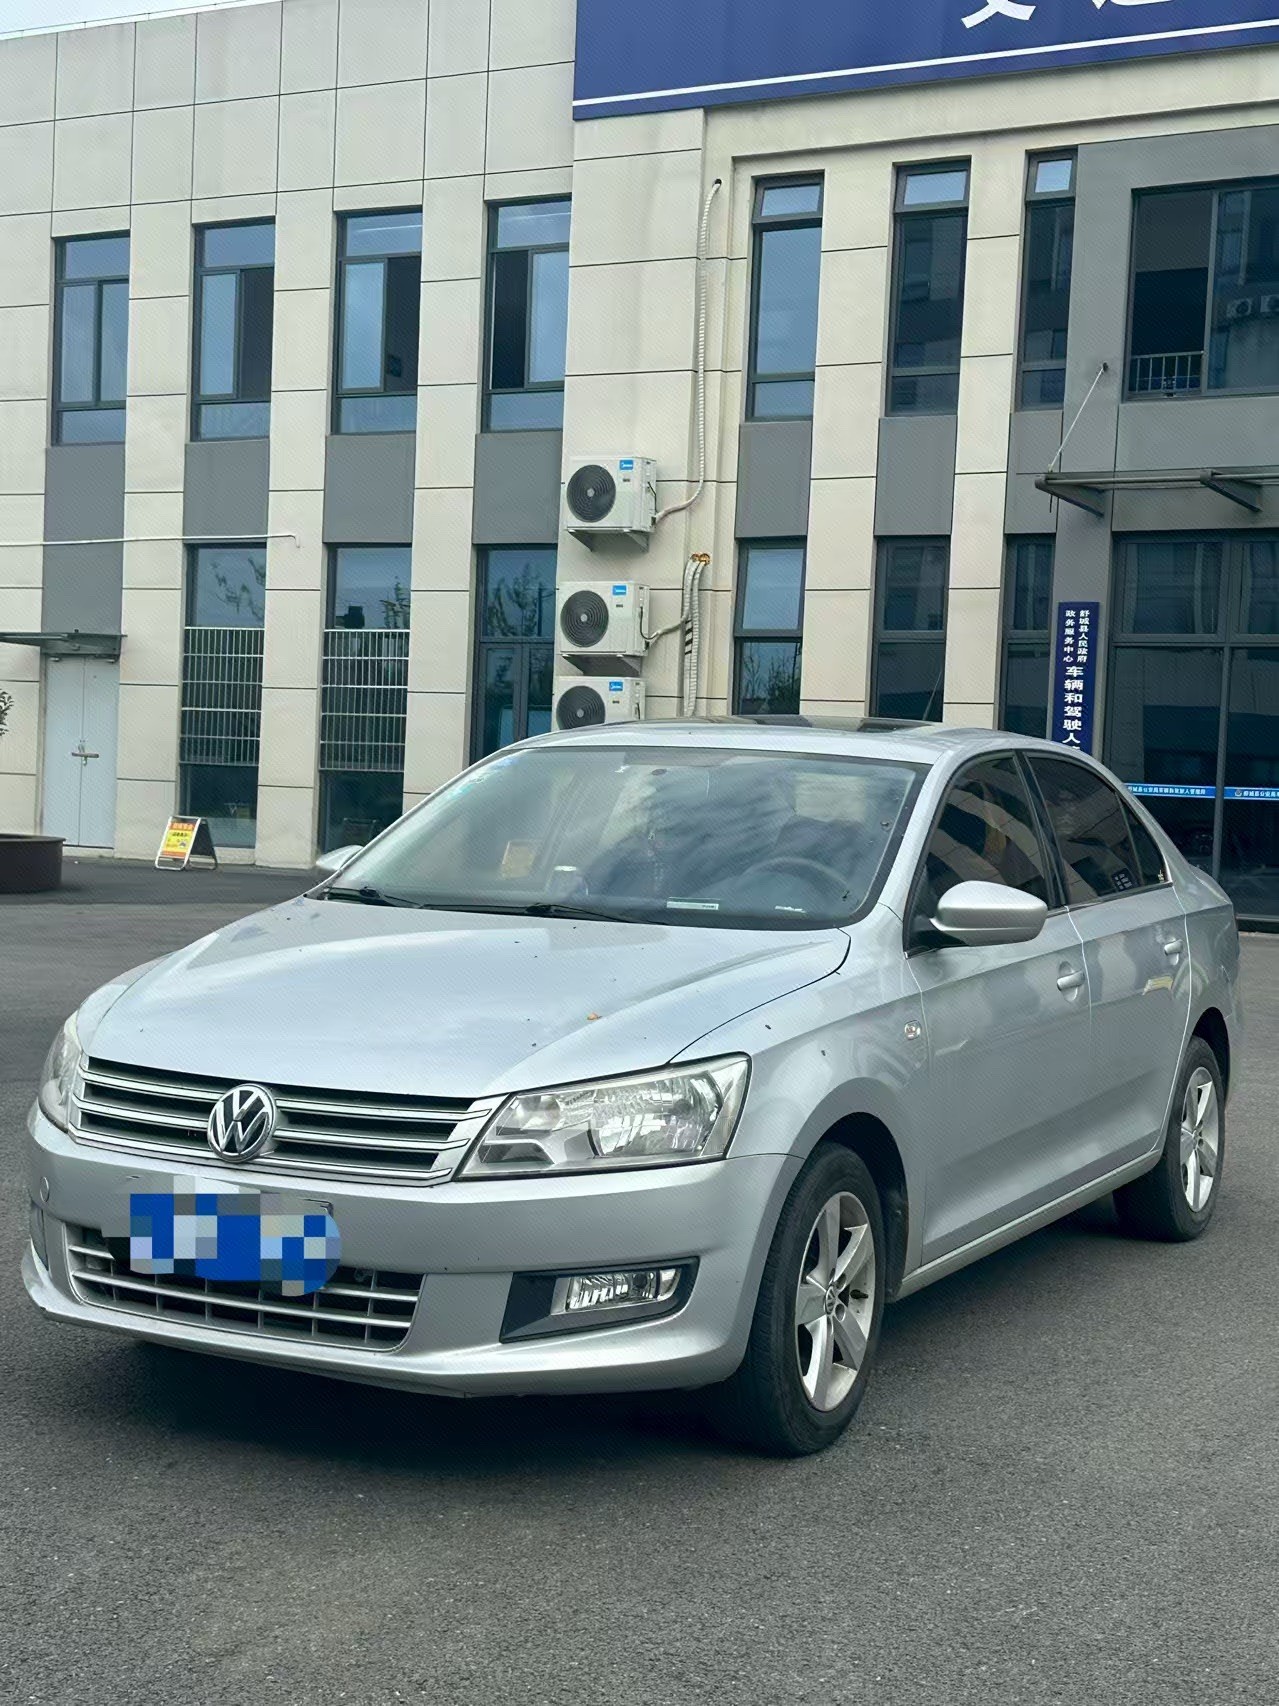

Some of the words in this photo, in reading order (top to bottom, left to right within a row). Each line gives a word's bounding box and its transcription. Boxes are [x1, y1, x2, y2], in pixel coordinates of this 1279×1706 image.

[1063, 610, 1076, 663] 政务服务中心
[1077, 610, 1090, 663] 舒城县人民政府
[1062, 666, 1084, 749] 车辆和驾驶人
